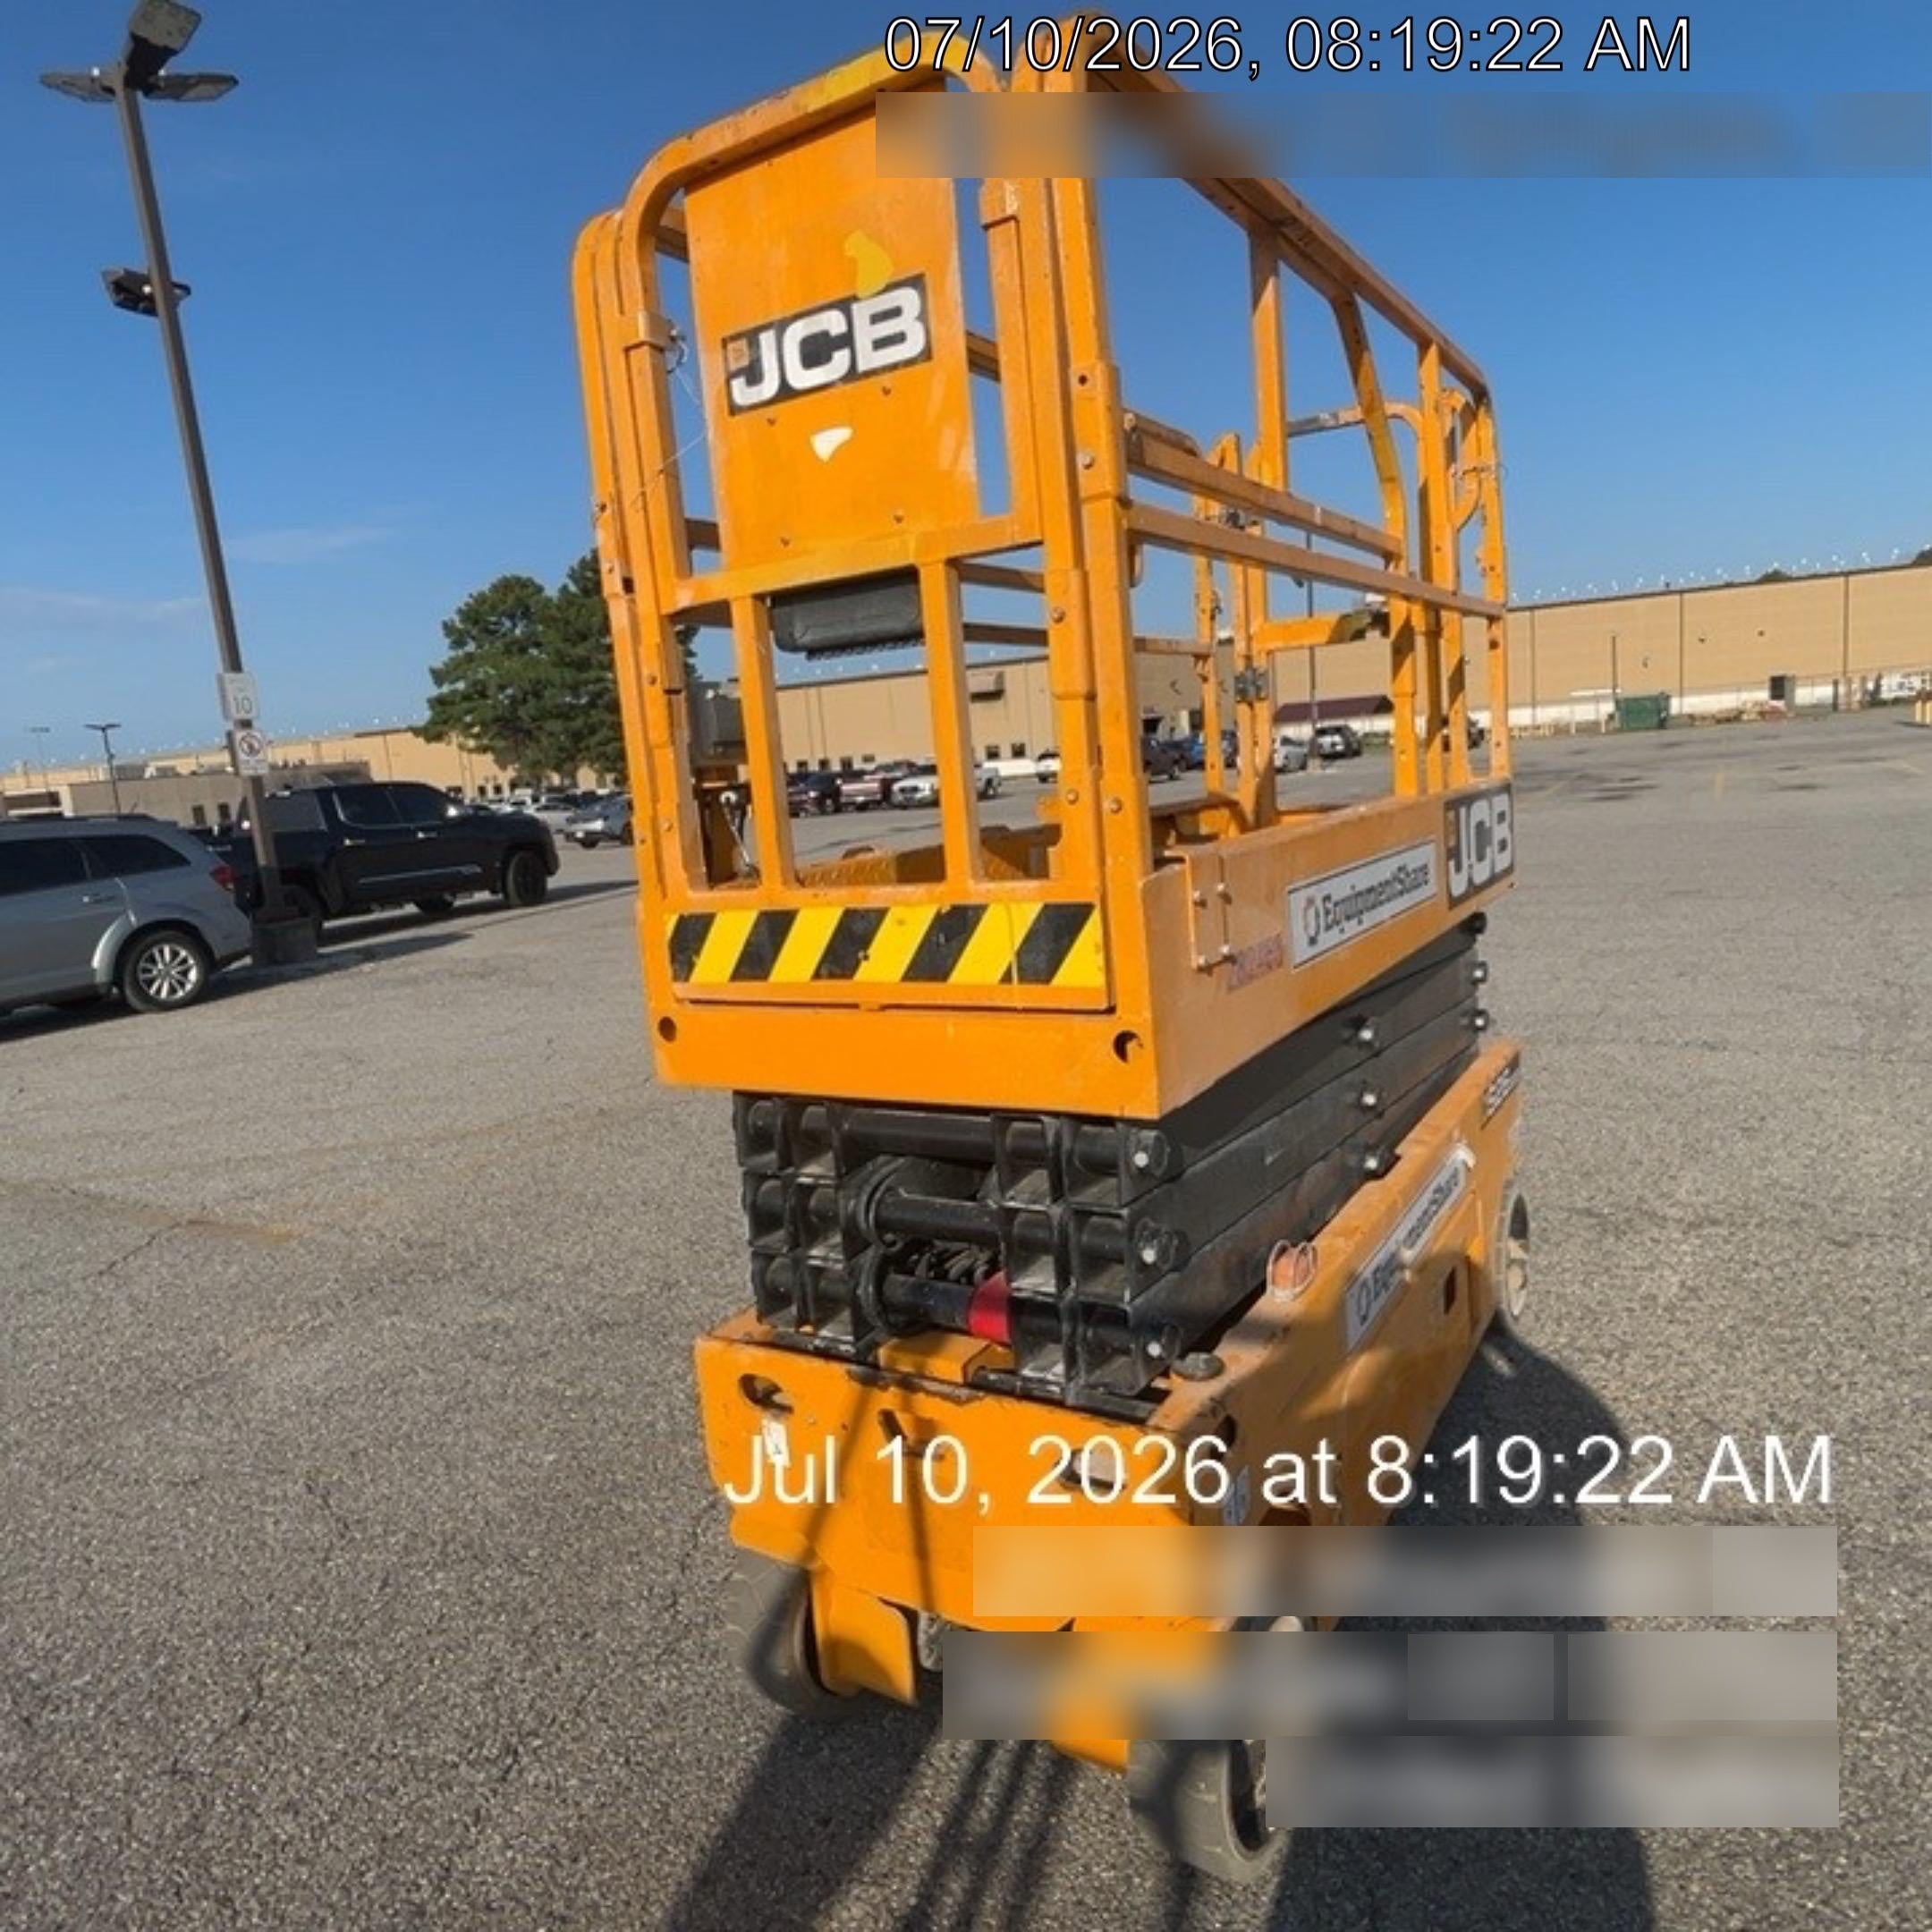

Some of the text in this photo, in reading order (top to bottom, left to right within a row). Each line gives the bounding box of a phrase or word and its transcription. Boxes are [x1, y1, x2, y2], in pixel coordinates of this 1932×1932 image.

[729, 286, 927, 406] JCB
[1322, 860, 1430, 934] EquipmentShare
[1448, 793, 1513, 897] JCB
